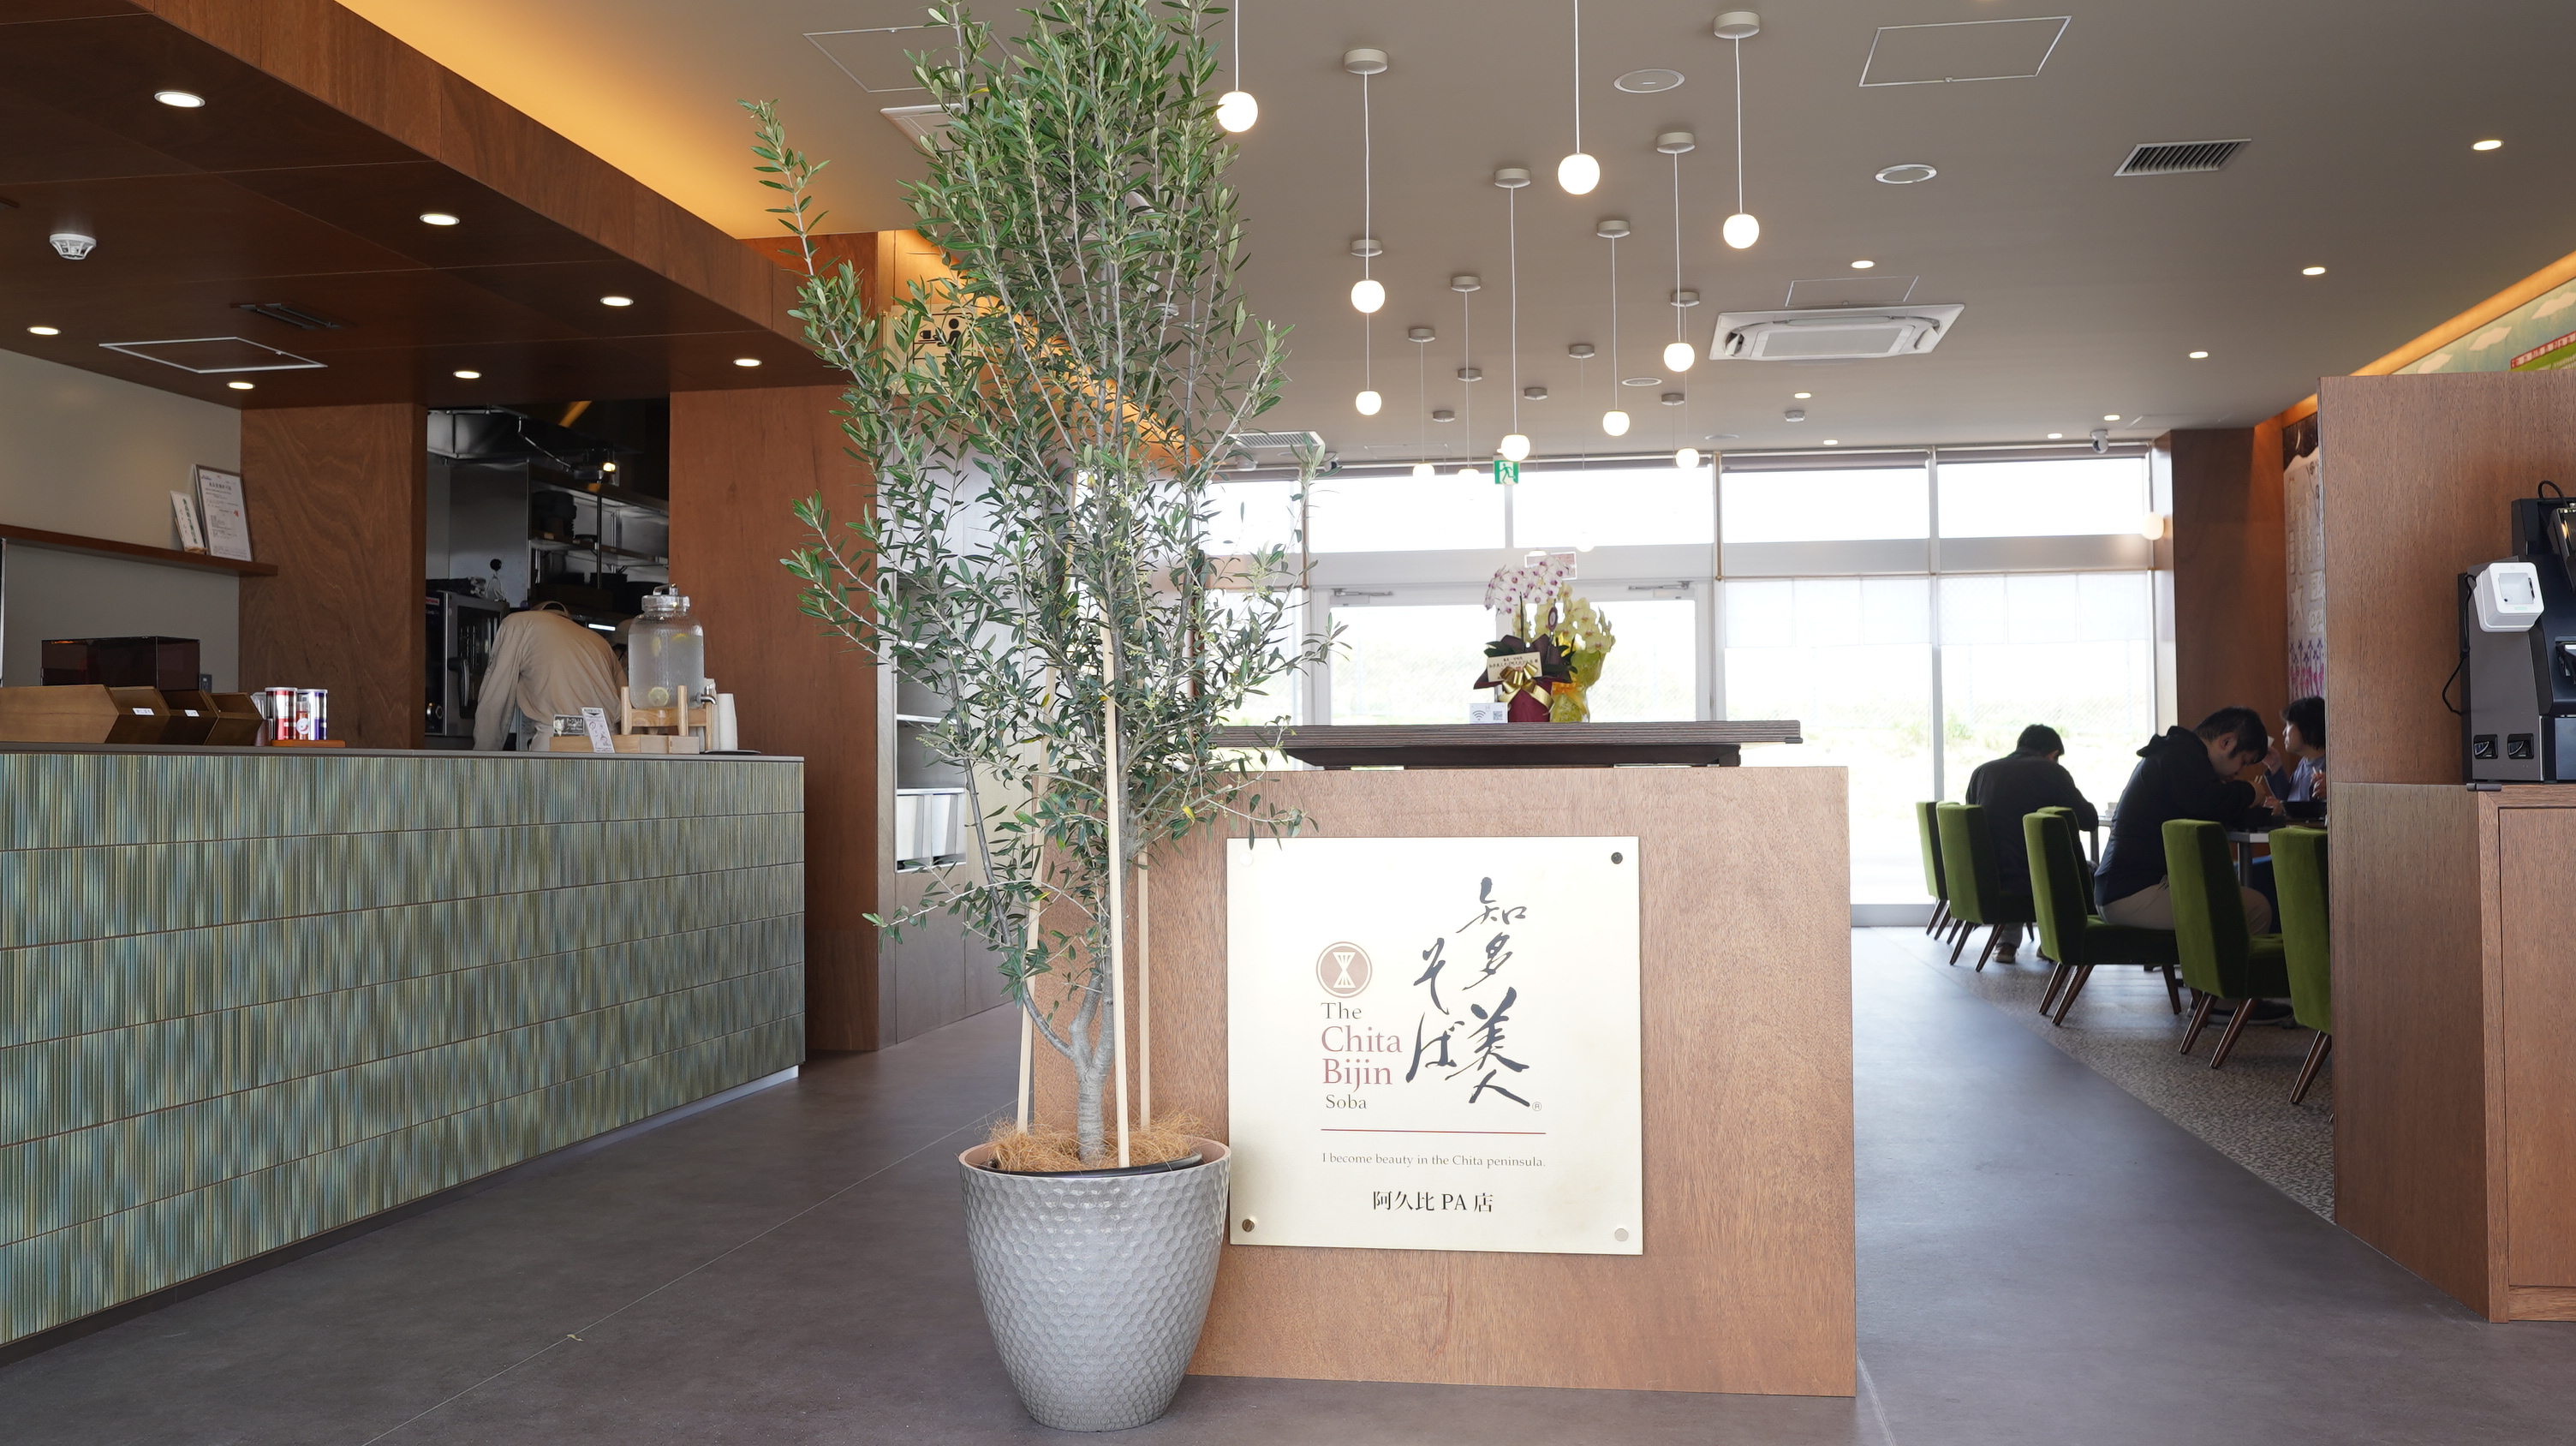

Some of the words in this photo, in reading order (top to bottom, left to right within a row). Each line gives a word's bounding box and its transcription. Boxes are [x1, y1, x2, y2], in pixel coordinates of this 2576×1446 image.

[1445, 876, 1530, 1108] 知多美人
[1321, 1001, 1363, 1019] The
[1406, 937, 1465, 1083] そば
[1321, 1025, 1403, 1053] Chita
[1322, 1058, 1393, 1093] Bijin
[1326, 1094, 1368, 1109] Soba
[1321, 1152, 1327, 1162] I
[1329, 1153, 1373, 1163] become
[1375, 1154, 1414, 1168] beauty
[1417, 1155, 1428, 1164] in
[1432, 1155, 1449, 1165] the
[1452, 1155, 1483, 1166] Chita
[1487, 1156, 1546, 1168] peninsula.
[1373, 1191, 1435, 1211] 阿久比
[1441, 1193, 1467, 1210] PA
[1473, 1192, 1494, 1212] 店
